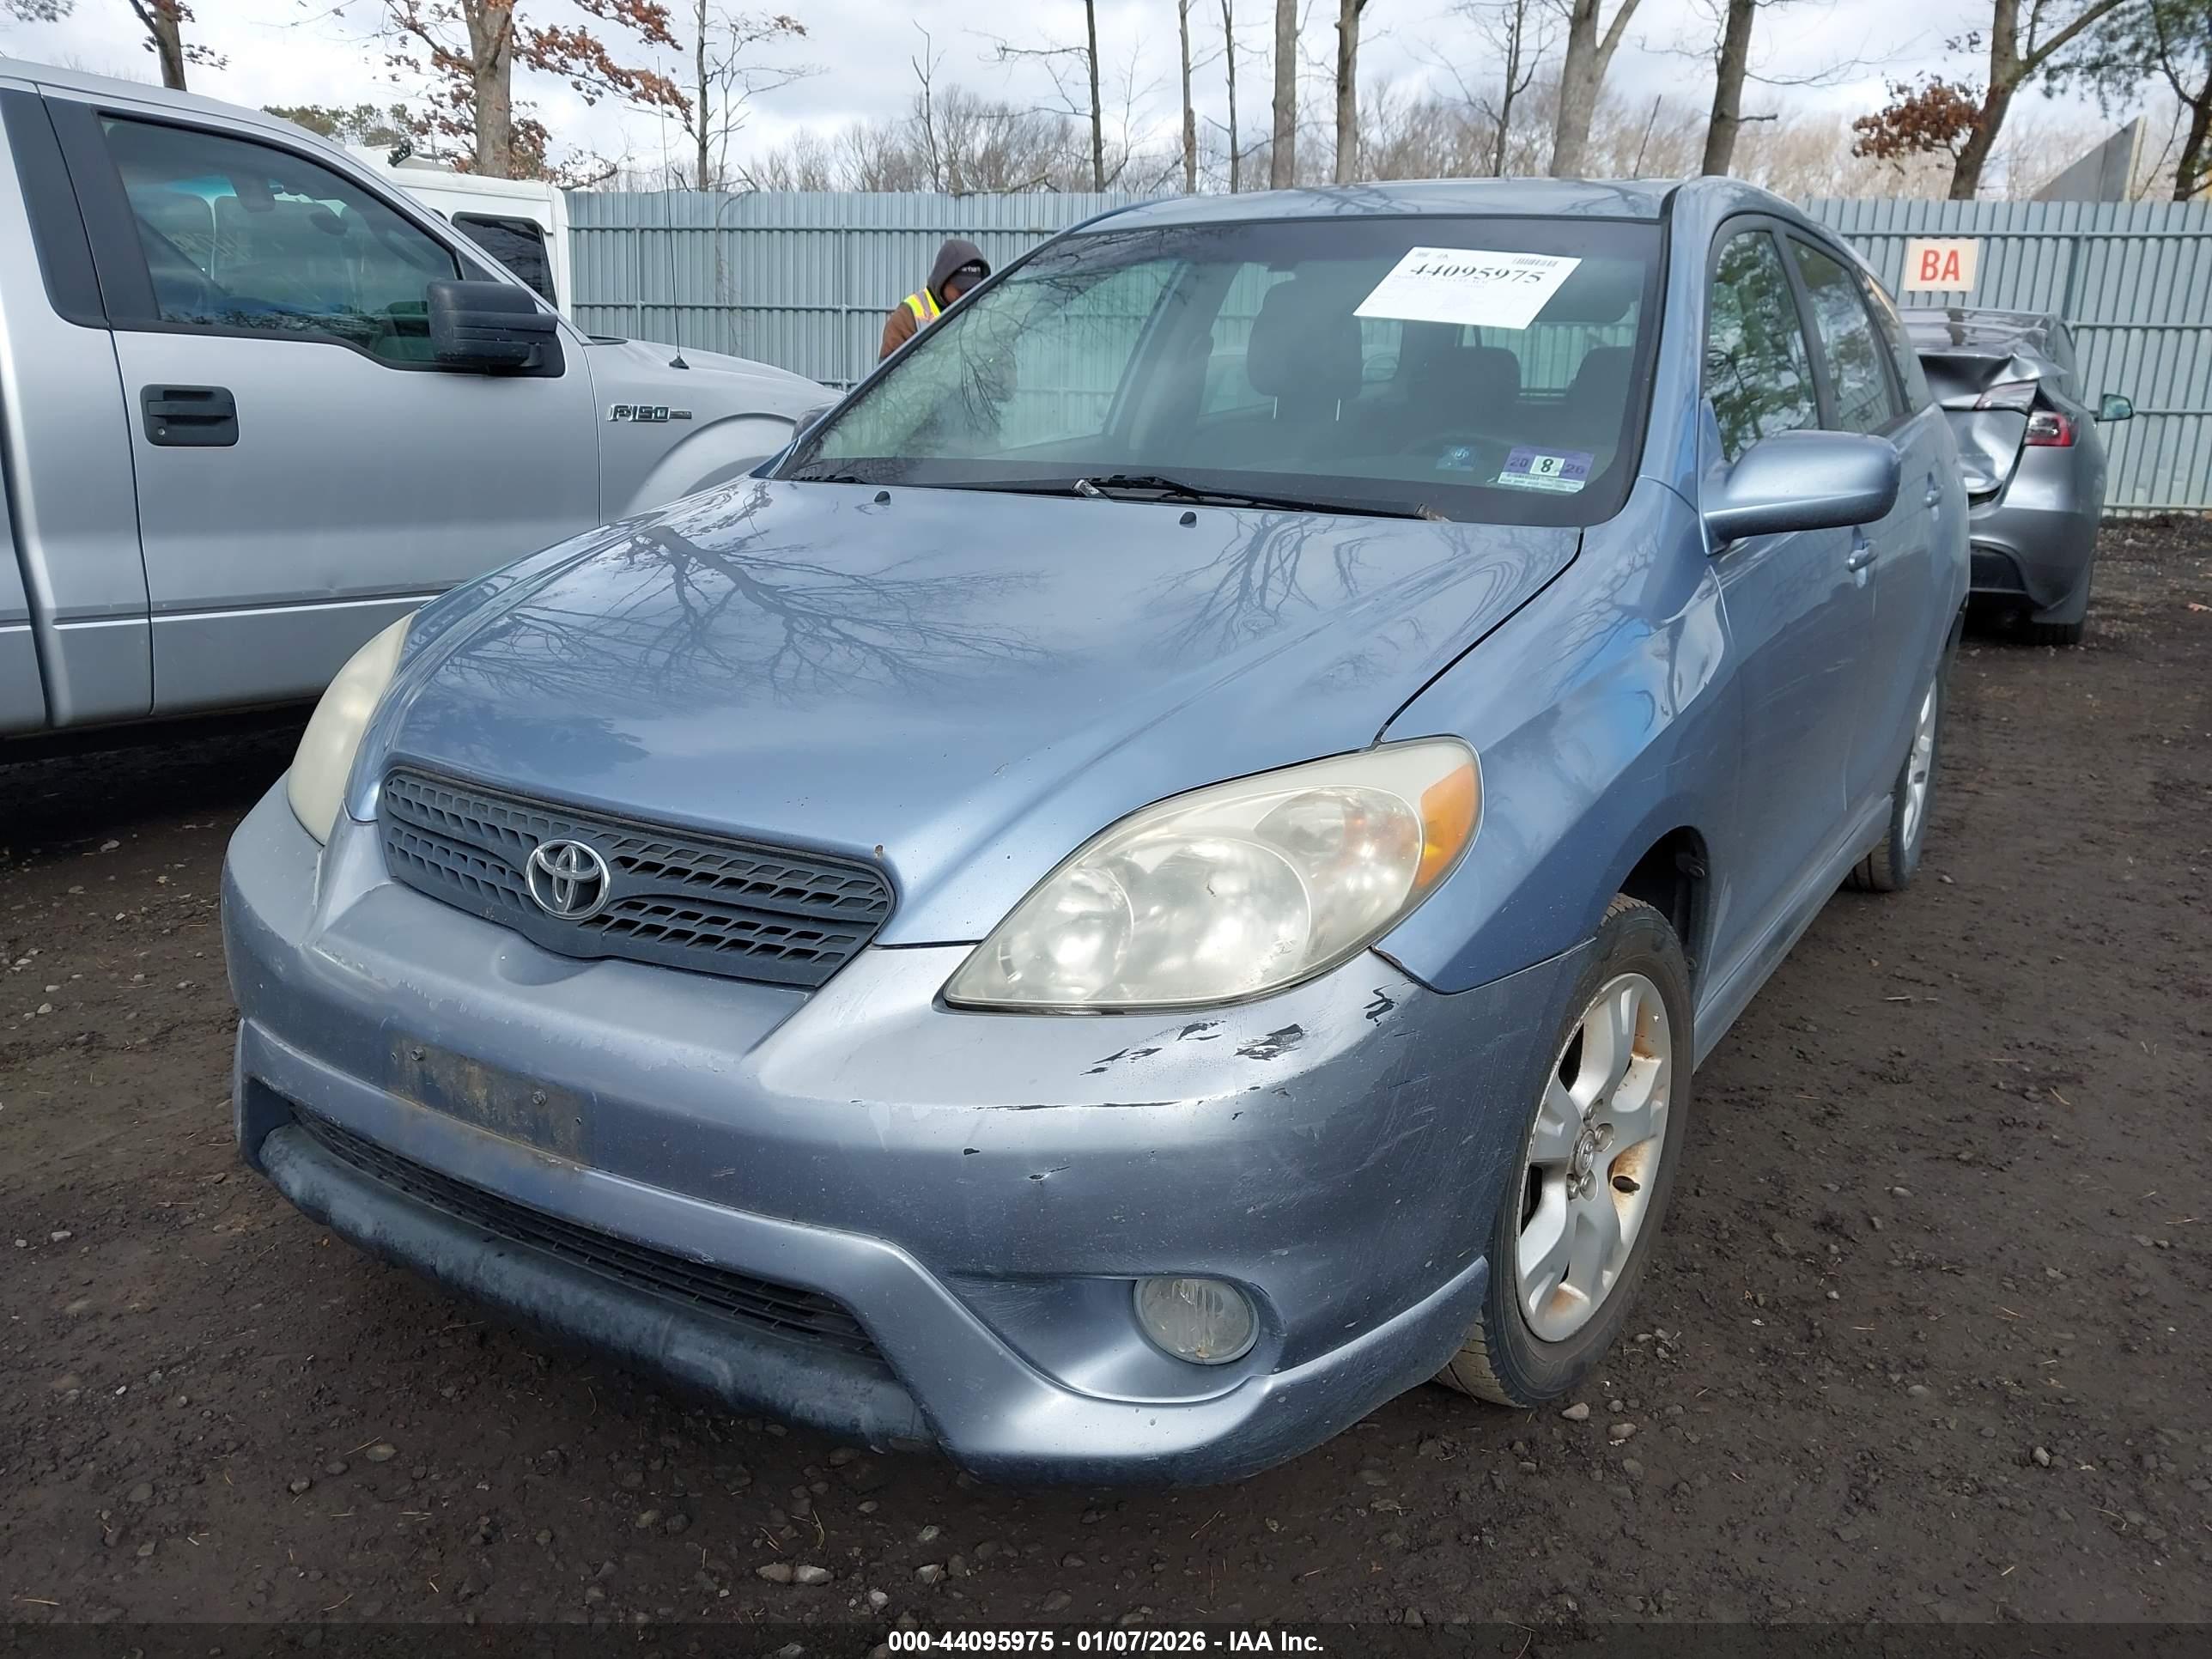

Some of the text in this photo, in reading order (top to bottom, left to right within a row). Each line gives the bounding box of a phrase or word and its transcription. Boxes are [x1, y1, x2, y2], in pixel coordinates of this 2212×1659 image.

[1410, 263, 1546, 284] 44095975
[1920, 249, 1960, 282] BA
[1540, 459, 1554, 473] 8
